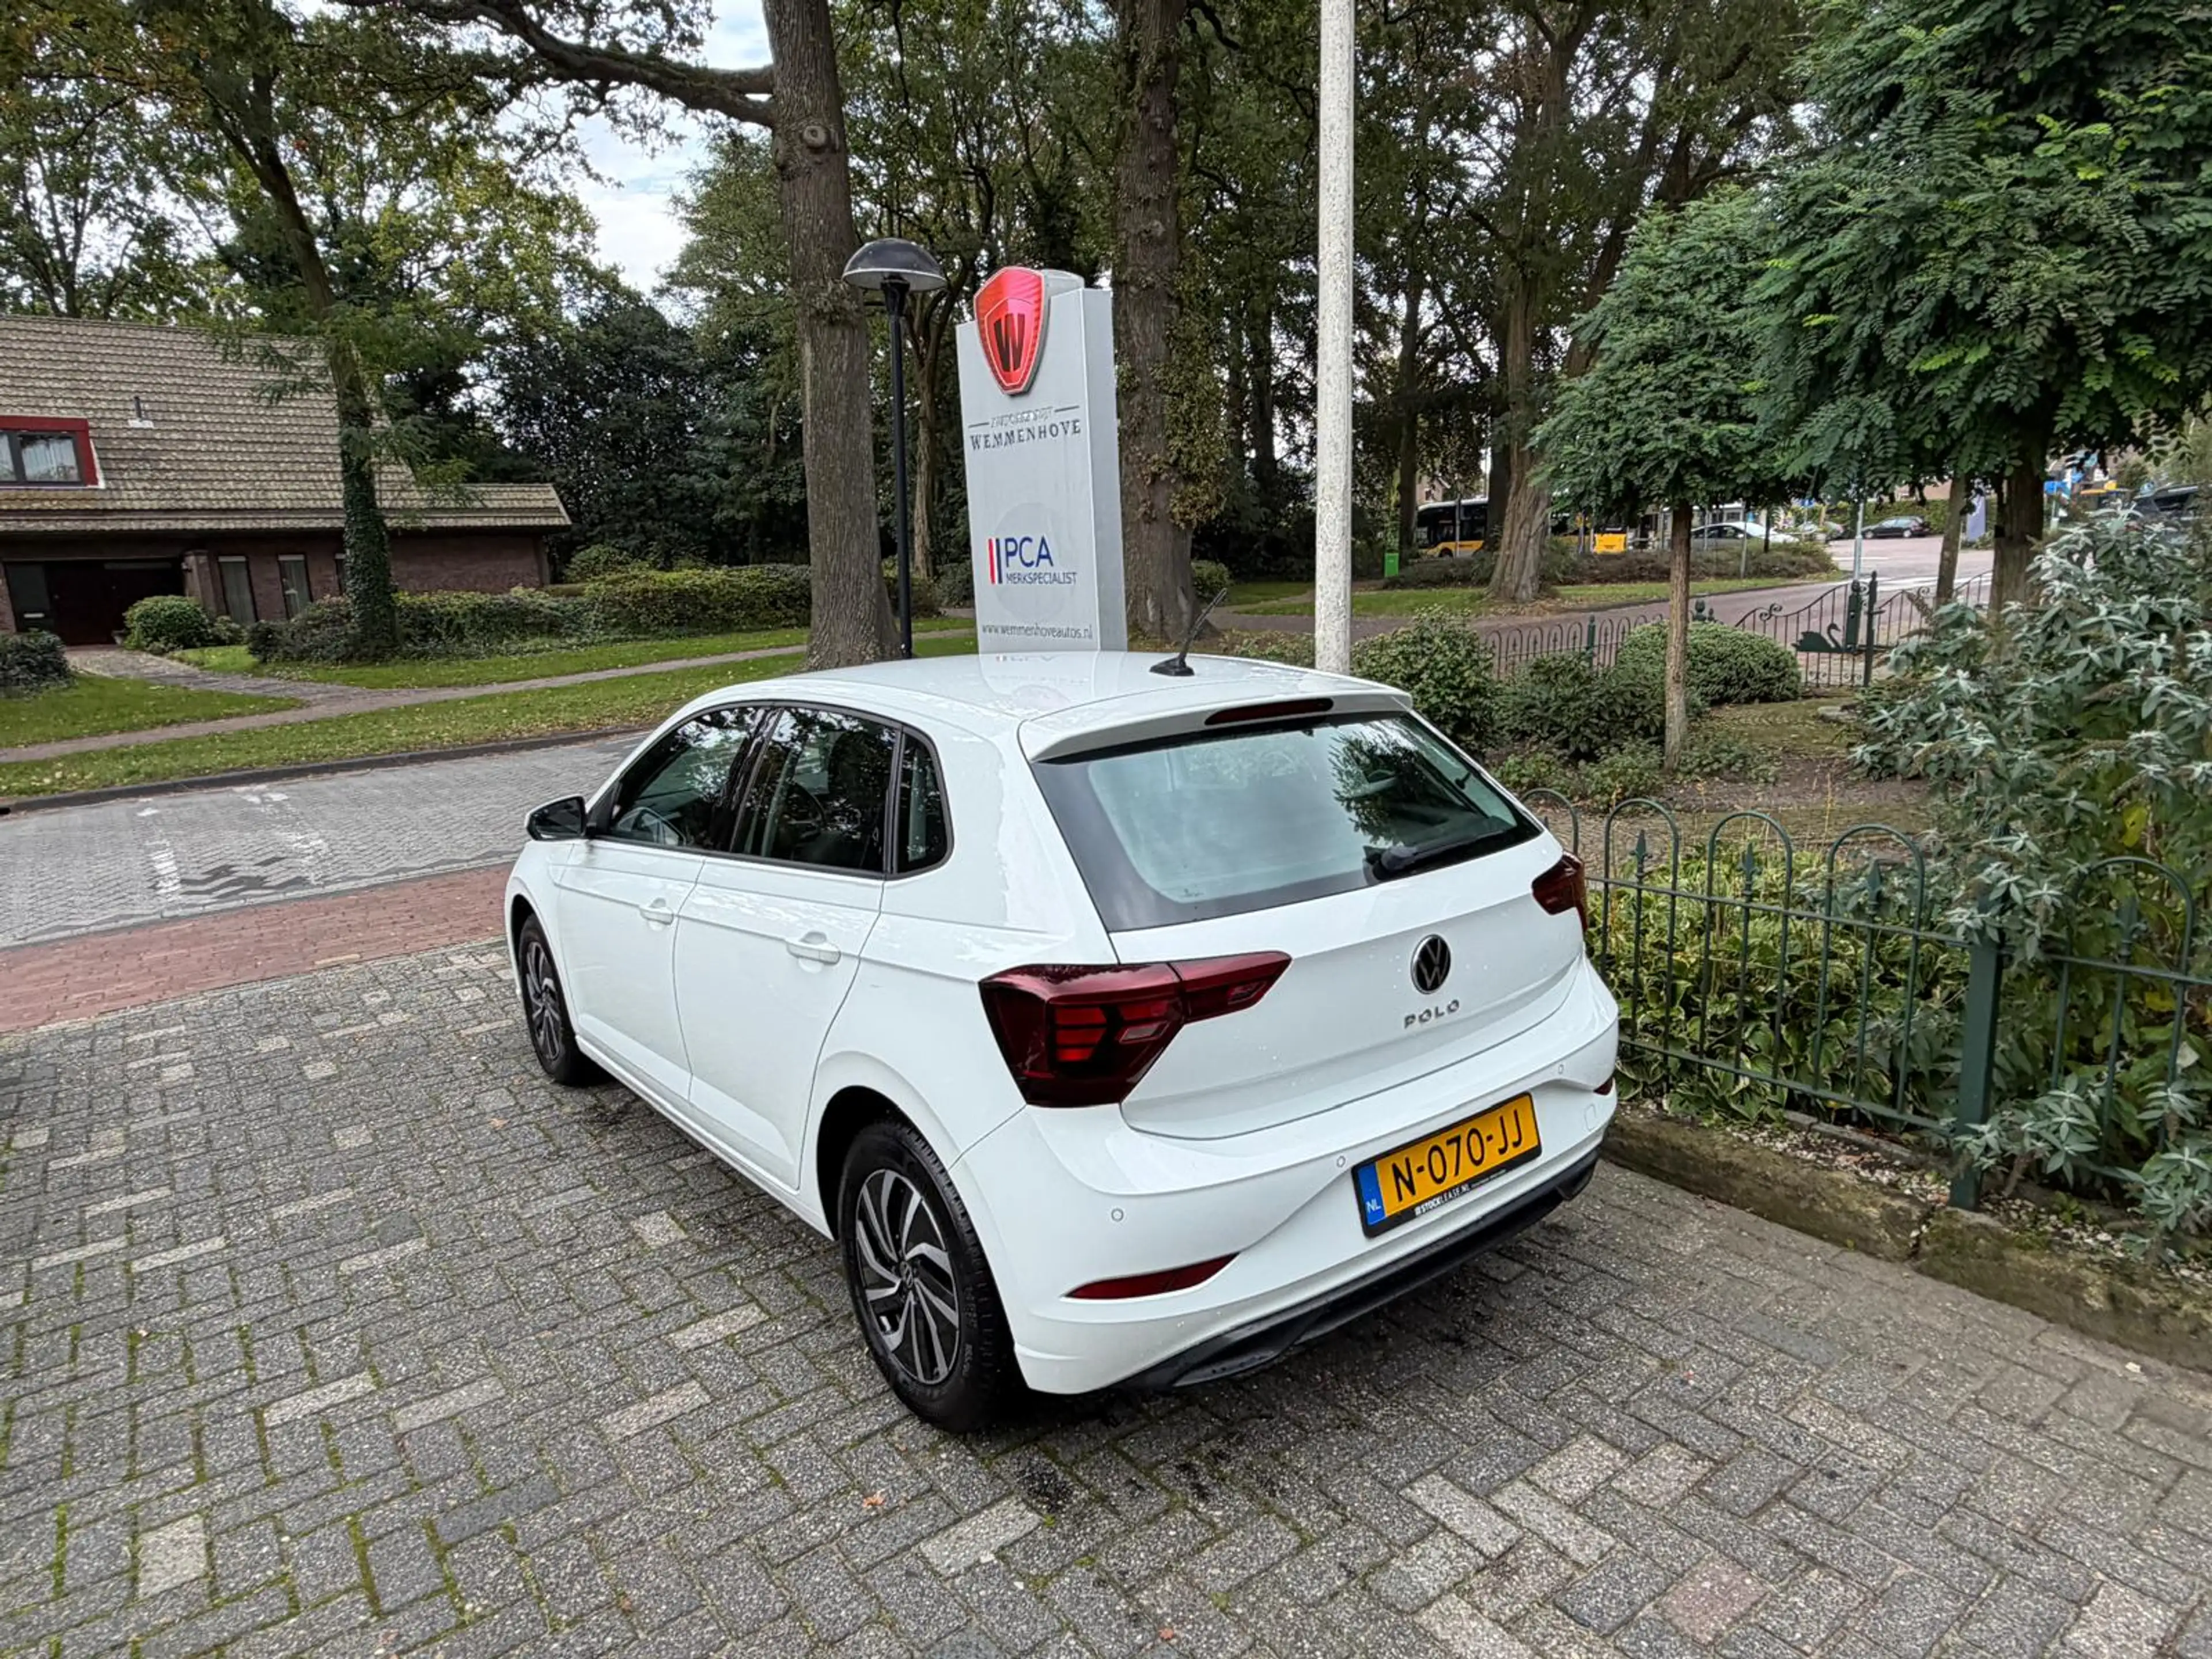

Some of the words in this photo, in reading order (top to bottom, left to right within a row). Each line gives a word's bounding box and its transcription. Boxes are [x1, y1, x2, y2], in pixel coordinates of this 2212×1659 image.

[970, 419, 1081, 450] WEMMENHOVE
[1005, 536, 1054, 567] PCA
[1006, 571, 1077, 584] MERKSPECIALIST
[1404, 999, 1460, 1029] POLO
[1391, 1109, 1522, 1202] N-070-JJ
[1366, 1198, 1381, 1214] NL
